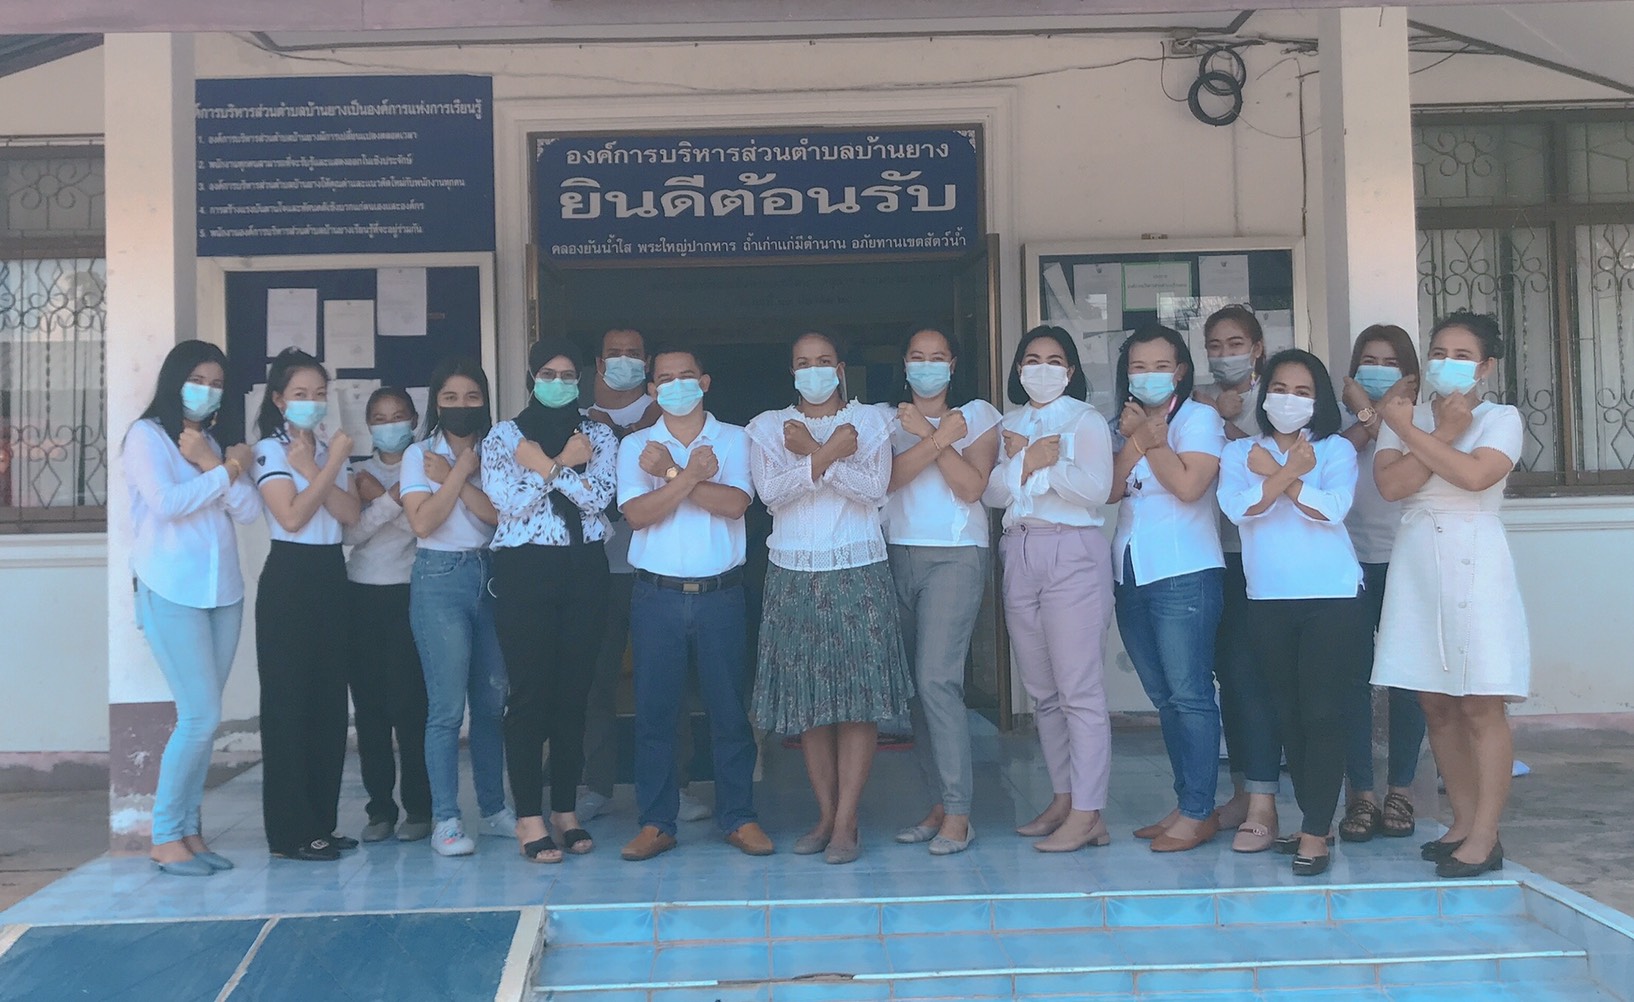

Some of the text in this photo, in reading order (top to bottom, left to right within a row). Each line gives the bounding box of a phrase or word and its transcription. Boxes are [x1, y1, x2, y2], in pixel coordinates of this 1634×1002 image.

[566, 135, 950, 165] องค์การบริหารส่วนตำบลบ้านยาง
[559, 170, 957, 219] ยินดีต้อนรับ
[551, 233, 632, 255] คลองยันน้ำใส
[743, 230, 847, 251] ถ้ำเก่าแก่มีตำนาน
[851, 226, 967, 249] อภัยทานเขตสัตว์น้ำ
